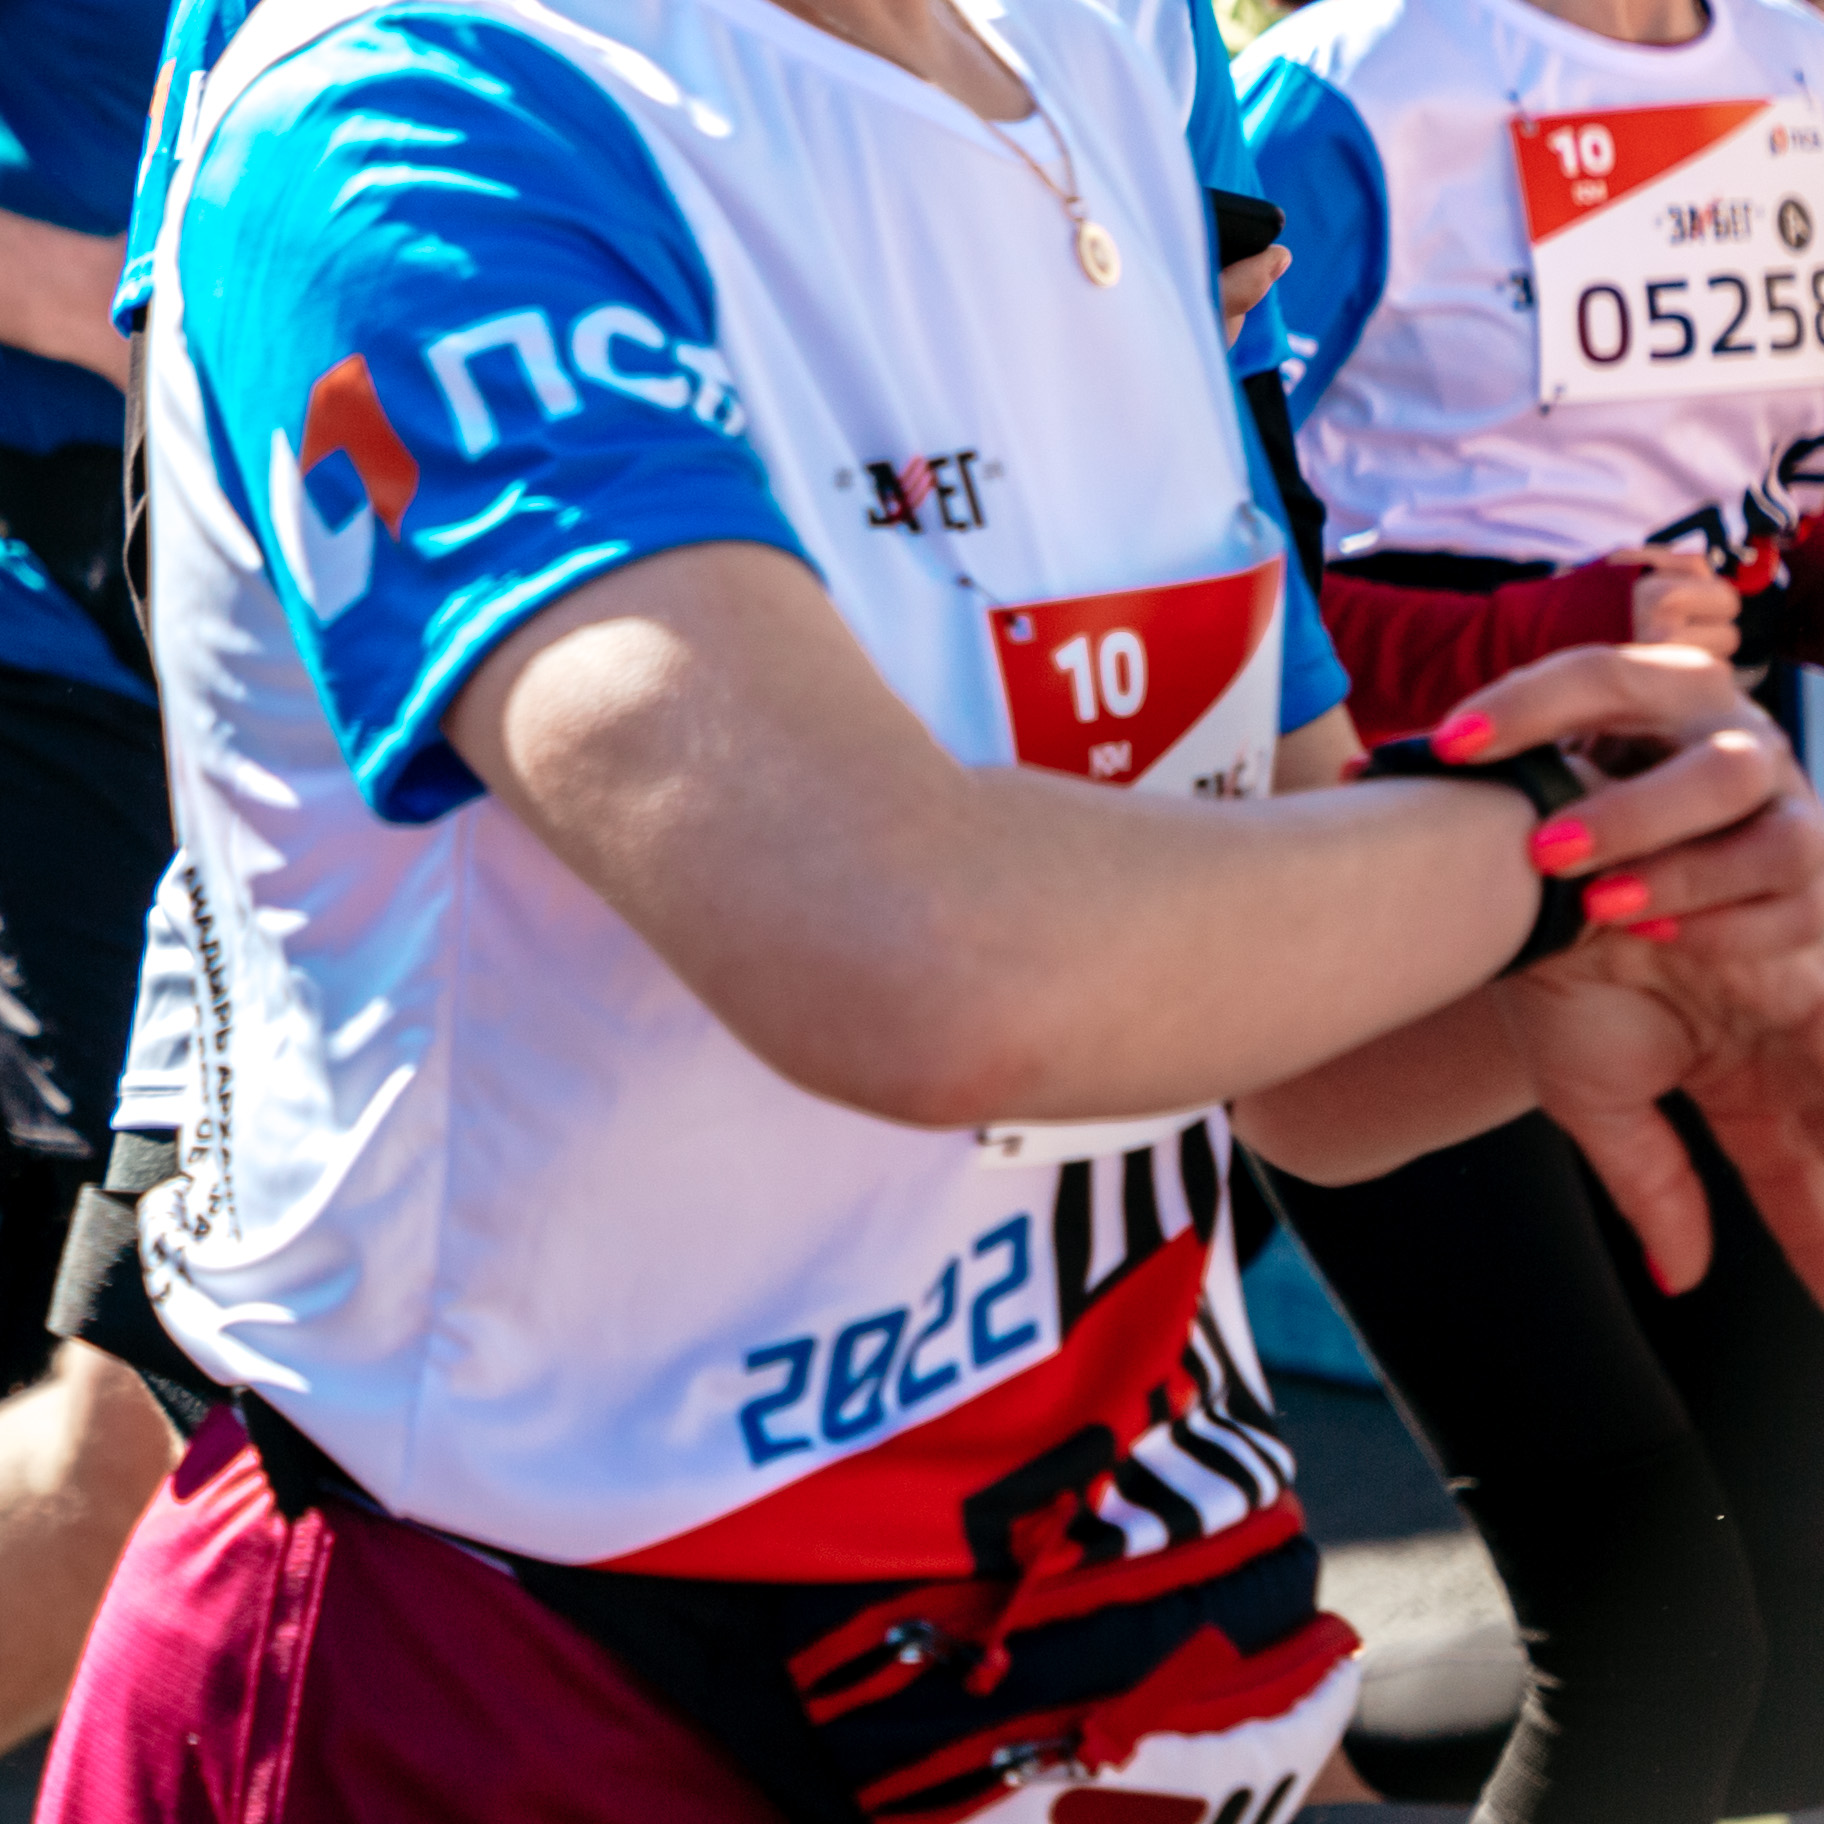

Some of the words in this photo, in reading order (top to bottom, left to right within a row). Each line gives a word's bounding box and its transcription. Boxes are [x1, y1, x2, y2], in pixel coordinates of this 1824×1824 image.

[1550, 123, 1615, 177] 10
[1054, 630, 1146, 722] 10
[739, 1210, 1040, 1470] 2022
